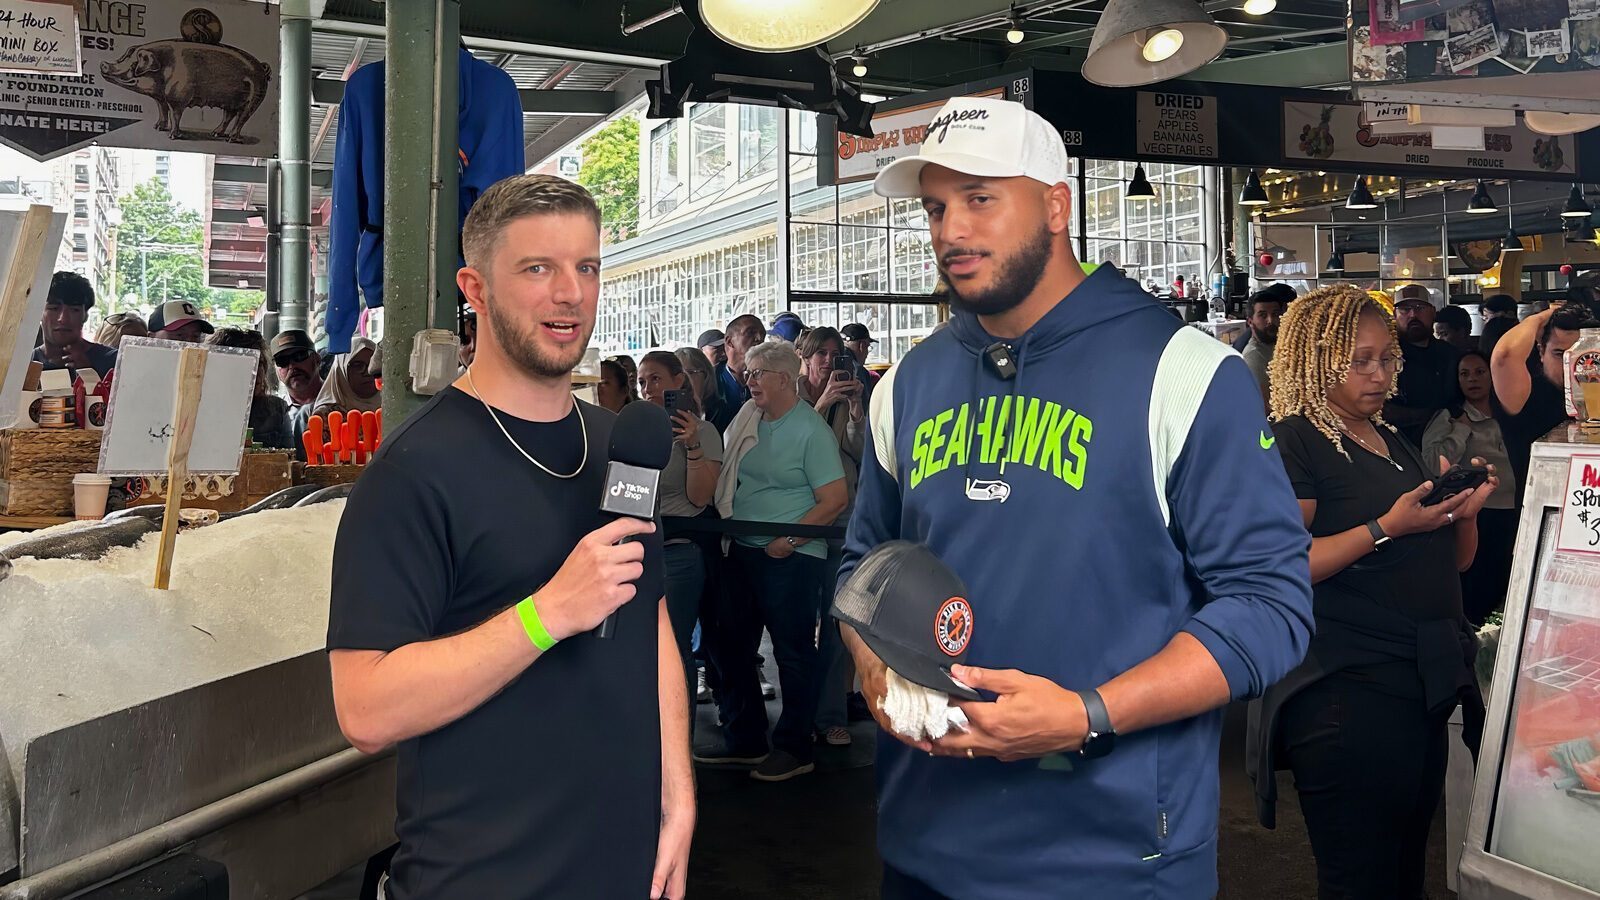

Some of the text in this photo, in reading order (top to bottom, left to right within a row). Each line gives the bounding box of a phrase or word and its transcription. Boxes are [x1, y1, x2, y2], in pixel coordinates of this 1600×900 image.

[17, 12, 63, 32] HOUR
[33, 37, 58, 55] BOX
[7, 80, 104, 98] FOUNDATION
[1014, 78, 1028, 93] 88
[27, 95, 57, 106] SENIOR
[59, 99, 90, 109] CENTER
[97, 101, 143, 113] PRESCHOOL
[1155, 93, 1204, 109] DRIED
[1161, 109, 1196, 120] PEARS
[56, 118, 110, 132] HERE!
[1157, 120, 1199, 132] APPLES
[1065, 131, 1081, 144] 88
[1153, 131, 1204, 144] BANANAS
[1143, 142, 1213, 156] VEGETABLES
[1405, 154, 1504, 168] DRIED PRODUCE
[182, 303, 195, 316] C
[910, 395, 1093, 491] SEAHAWKS
[624, 491, 642, 501] Shop
[626, 484, 649, 494] TikTok
